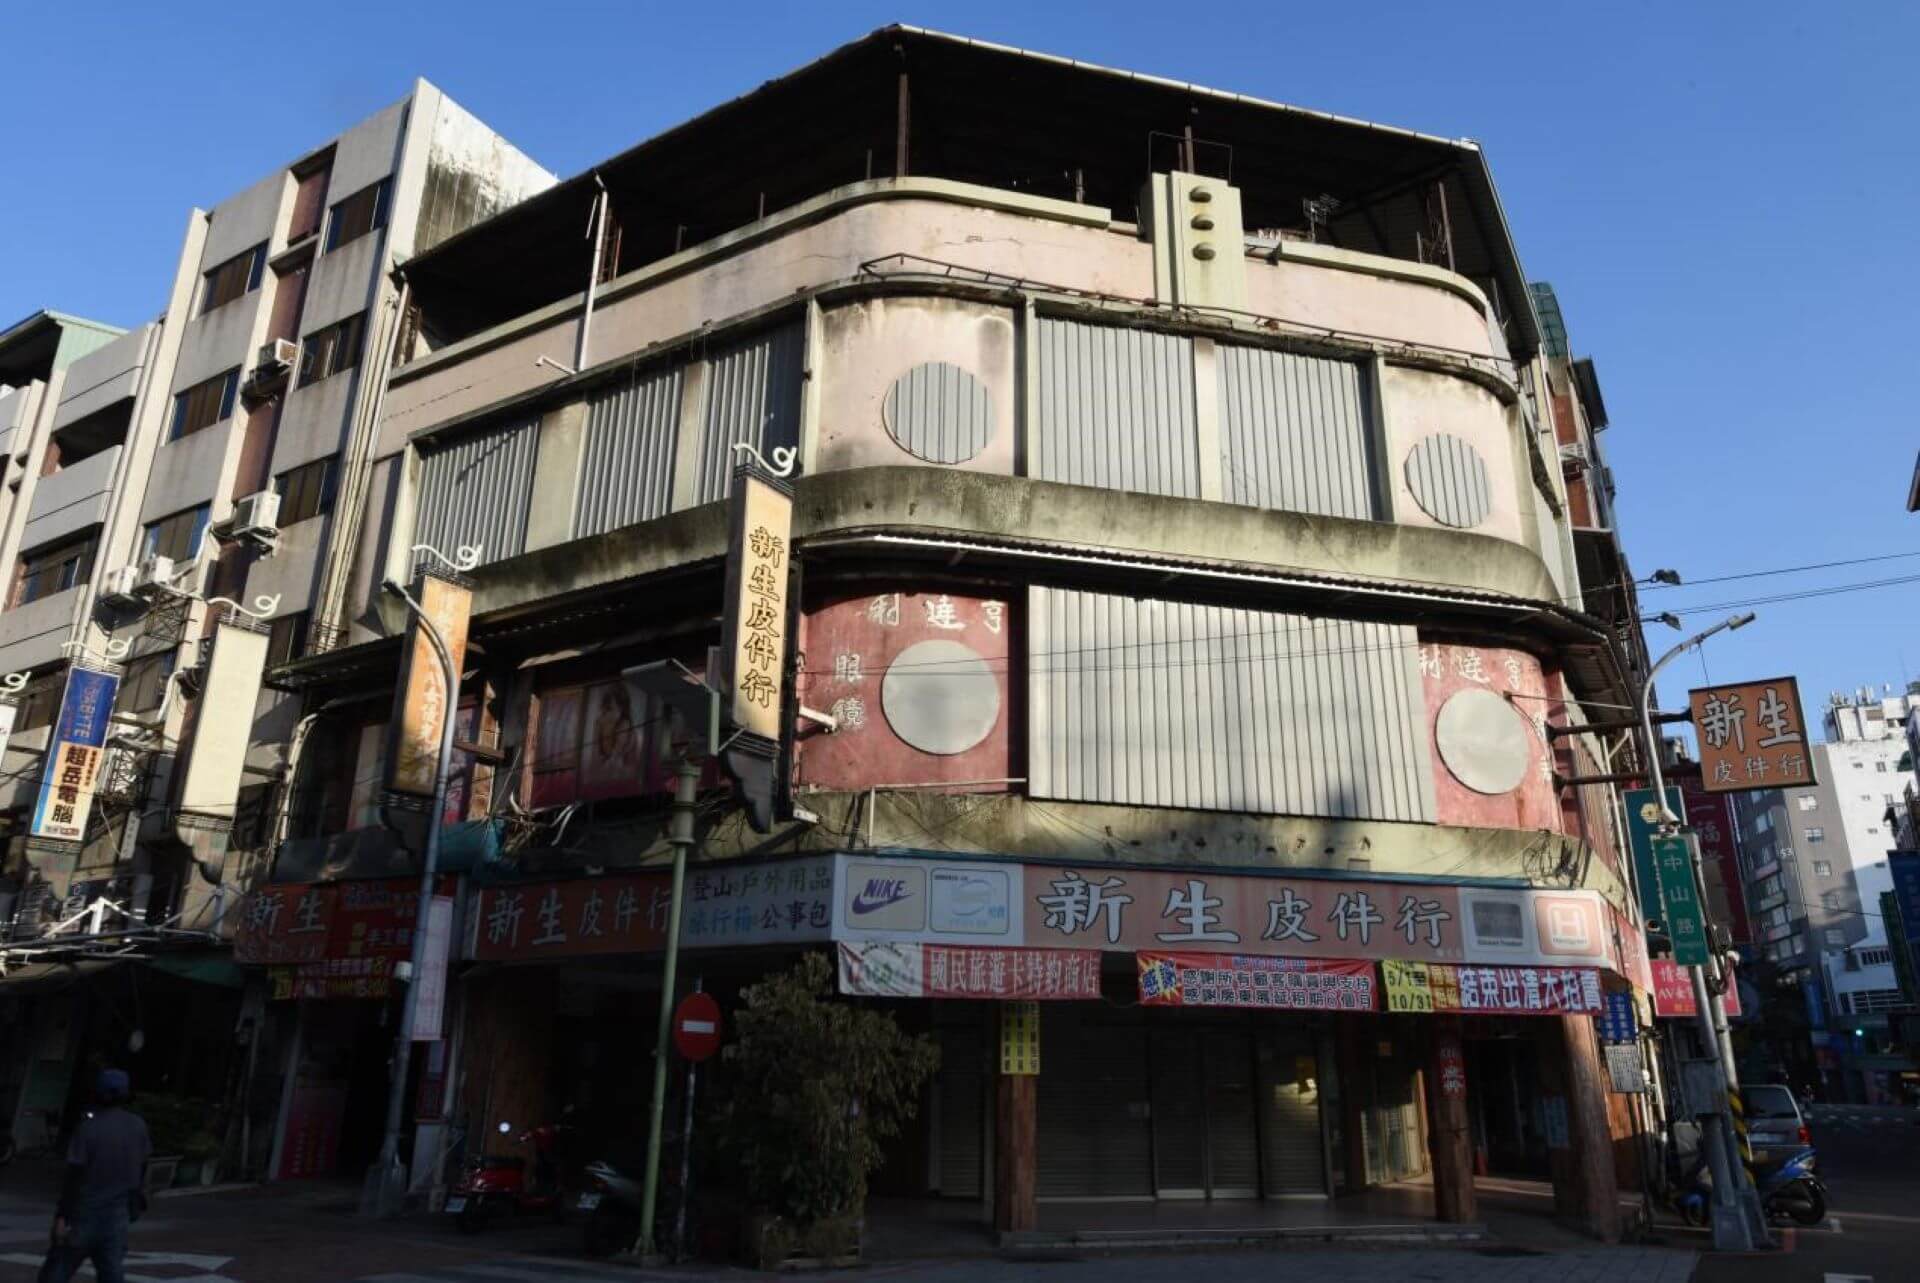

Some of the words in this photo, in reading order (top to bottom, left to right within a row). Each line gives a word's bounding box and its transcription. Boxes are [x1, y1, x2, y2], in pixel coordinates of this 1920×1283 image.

[741, 526, 784, 708] 新生皮件行
[1701, 688, 1801, 753] 新生
[1714, 754, 1805, 783] 皮件行
[247, 888, 326, 937] 新生
[863, 878, 907, 898] NIKE
[1037, 871, 1452, 948] 新生皮件行
[487, 886, 674, 949] 新生皮件行
[1391, 993, 1431, 1009] 10/31
[1459, 967, 1602, 1011] 結束出清大拍賣
